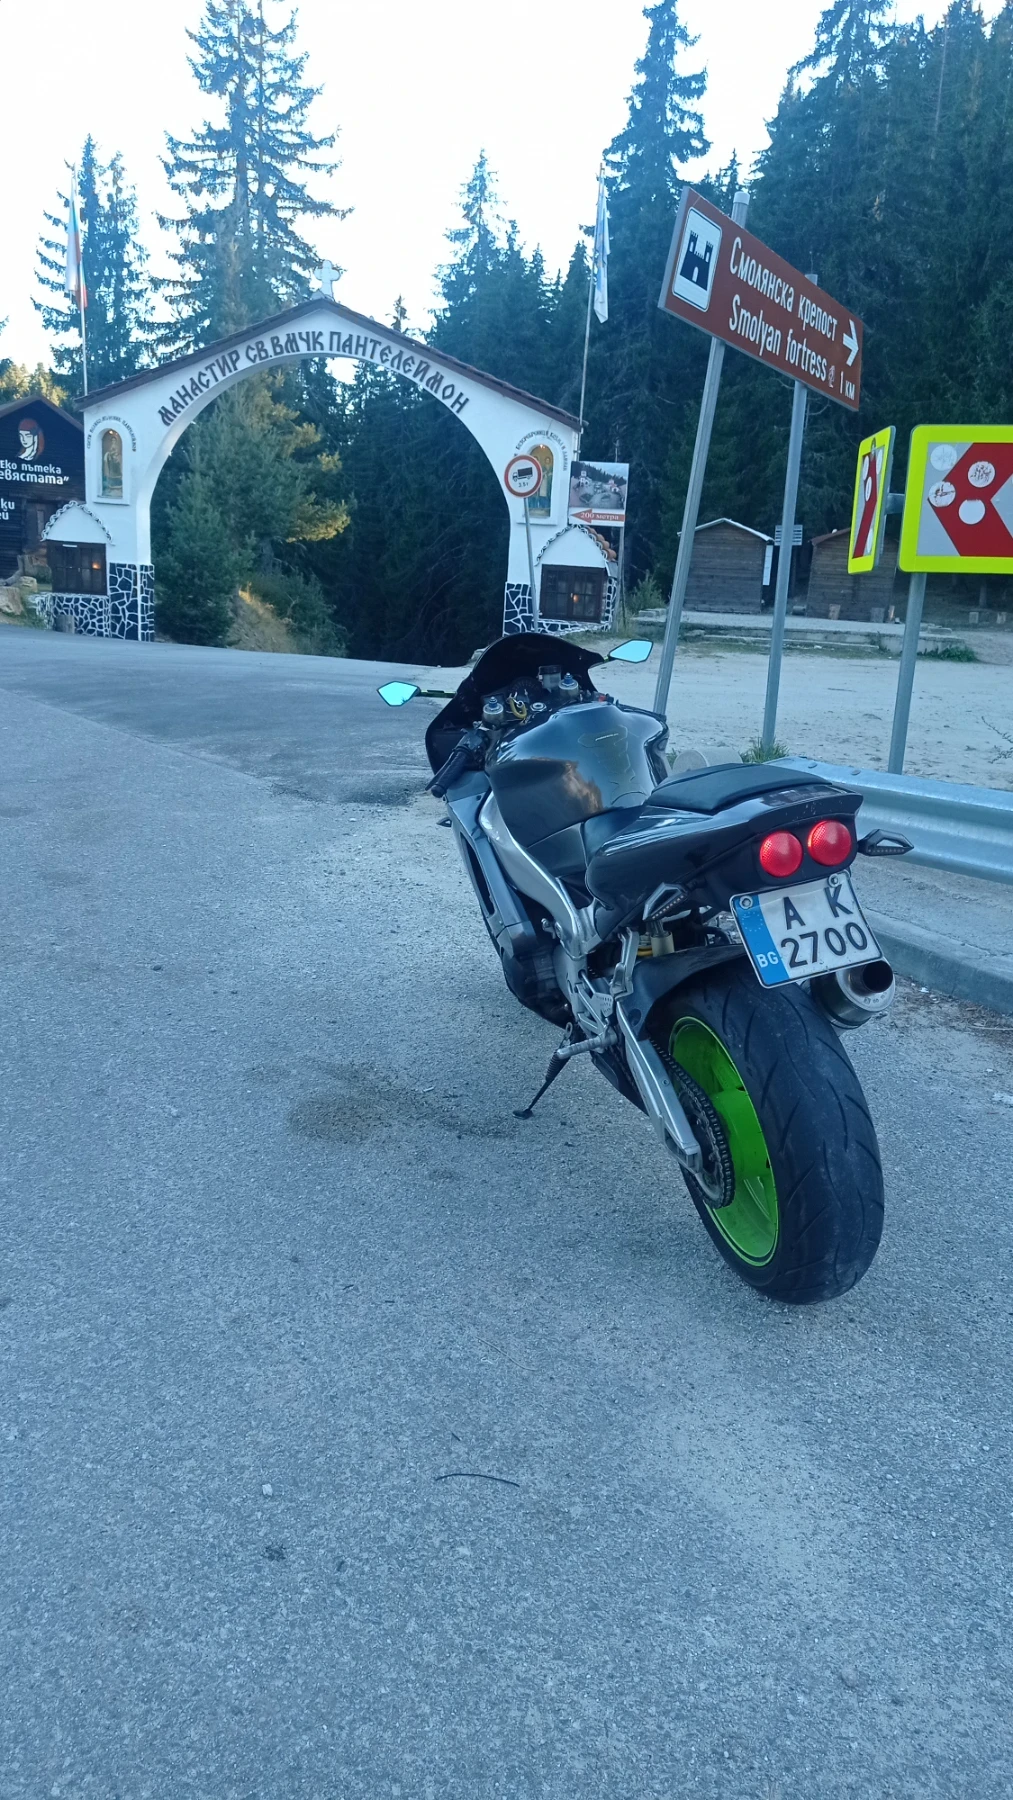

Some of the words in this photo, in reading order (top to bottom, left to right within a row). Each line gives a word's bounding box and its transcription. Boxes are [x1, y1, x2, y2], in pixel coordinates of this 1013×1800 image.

[730, 237, 794, 312] Смолянска
[798, 294, 838, 342] крепост
[729, 294, 781, 356] Smolyan
[785, 329, 827, 381] fortress
[157, 350, 240, 427] МАНАСТИР
[329, 331, 470, 414] ПАНТЕЛЕЙМОН
[21, 463, 62, 474] пътека
[580, 511, 595, 519] 200
[783, 896, 806, 930] A
[824, 884, 853, 918] K
[756, 951, 779, 968] BG
[780, 922, 868, 968] 2700
